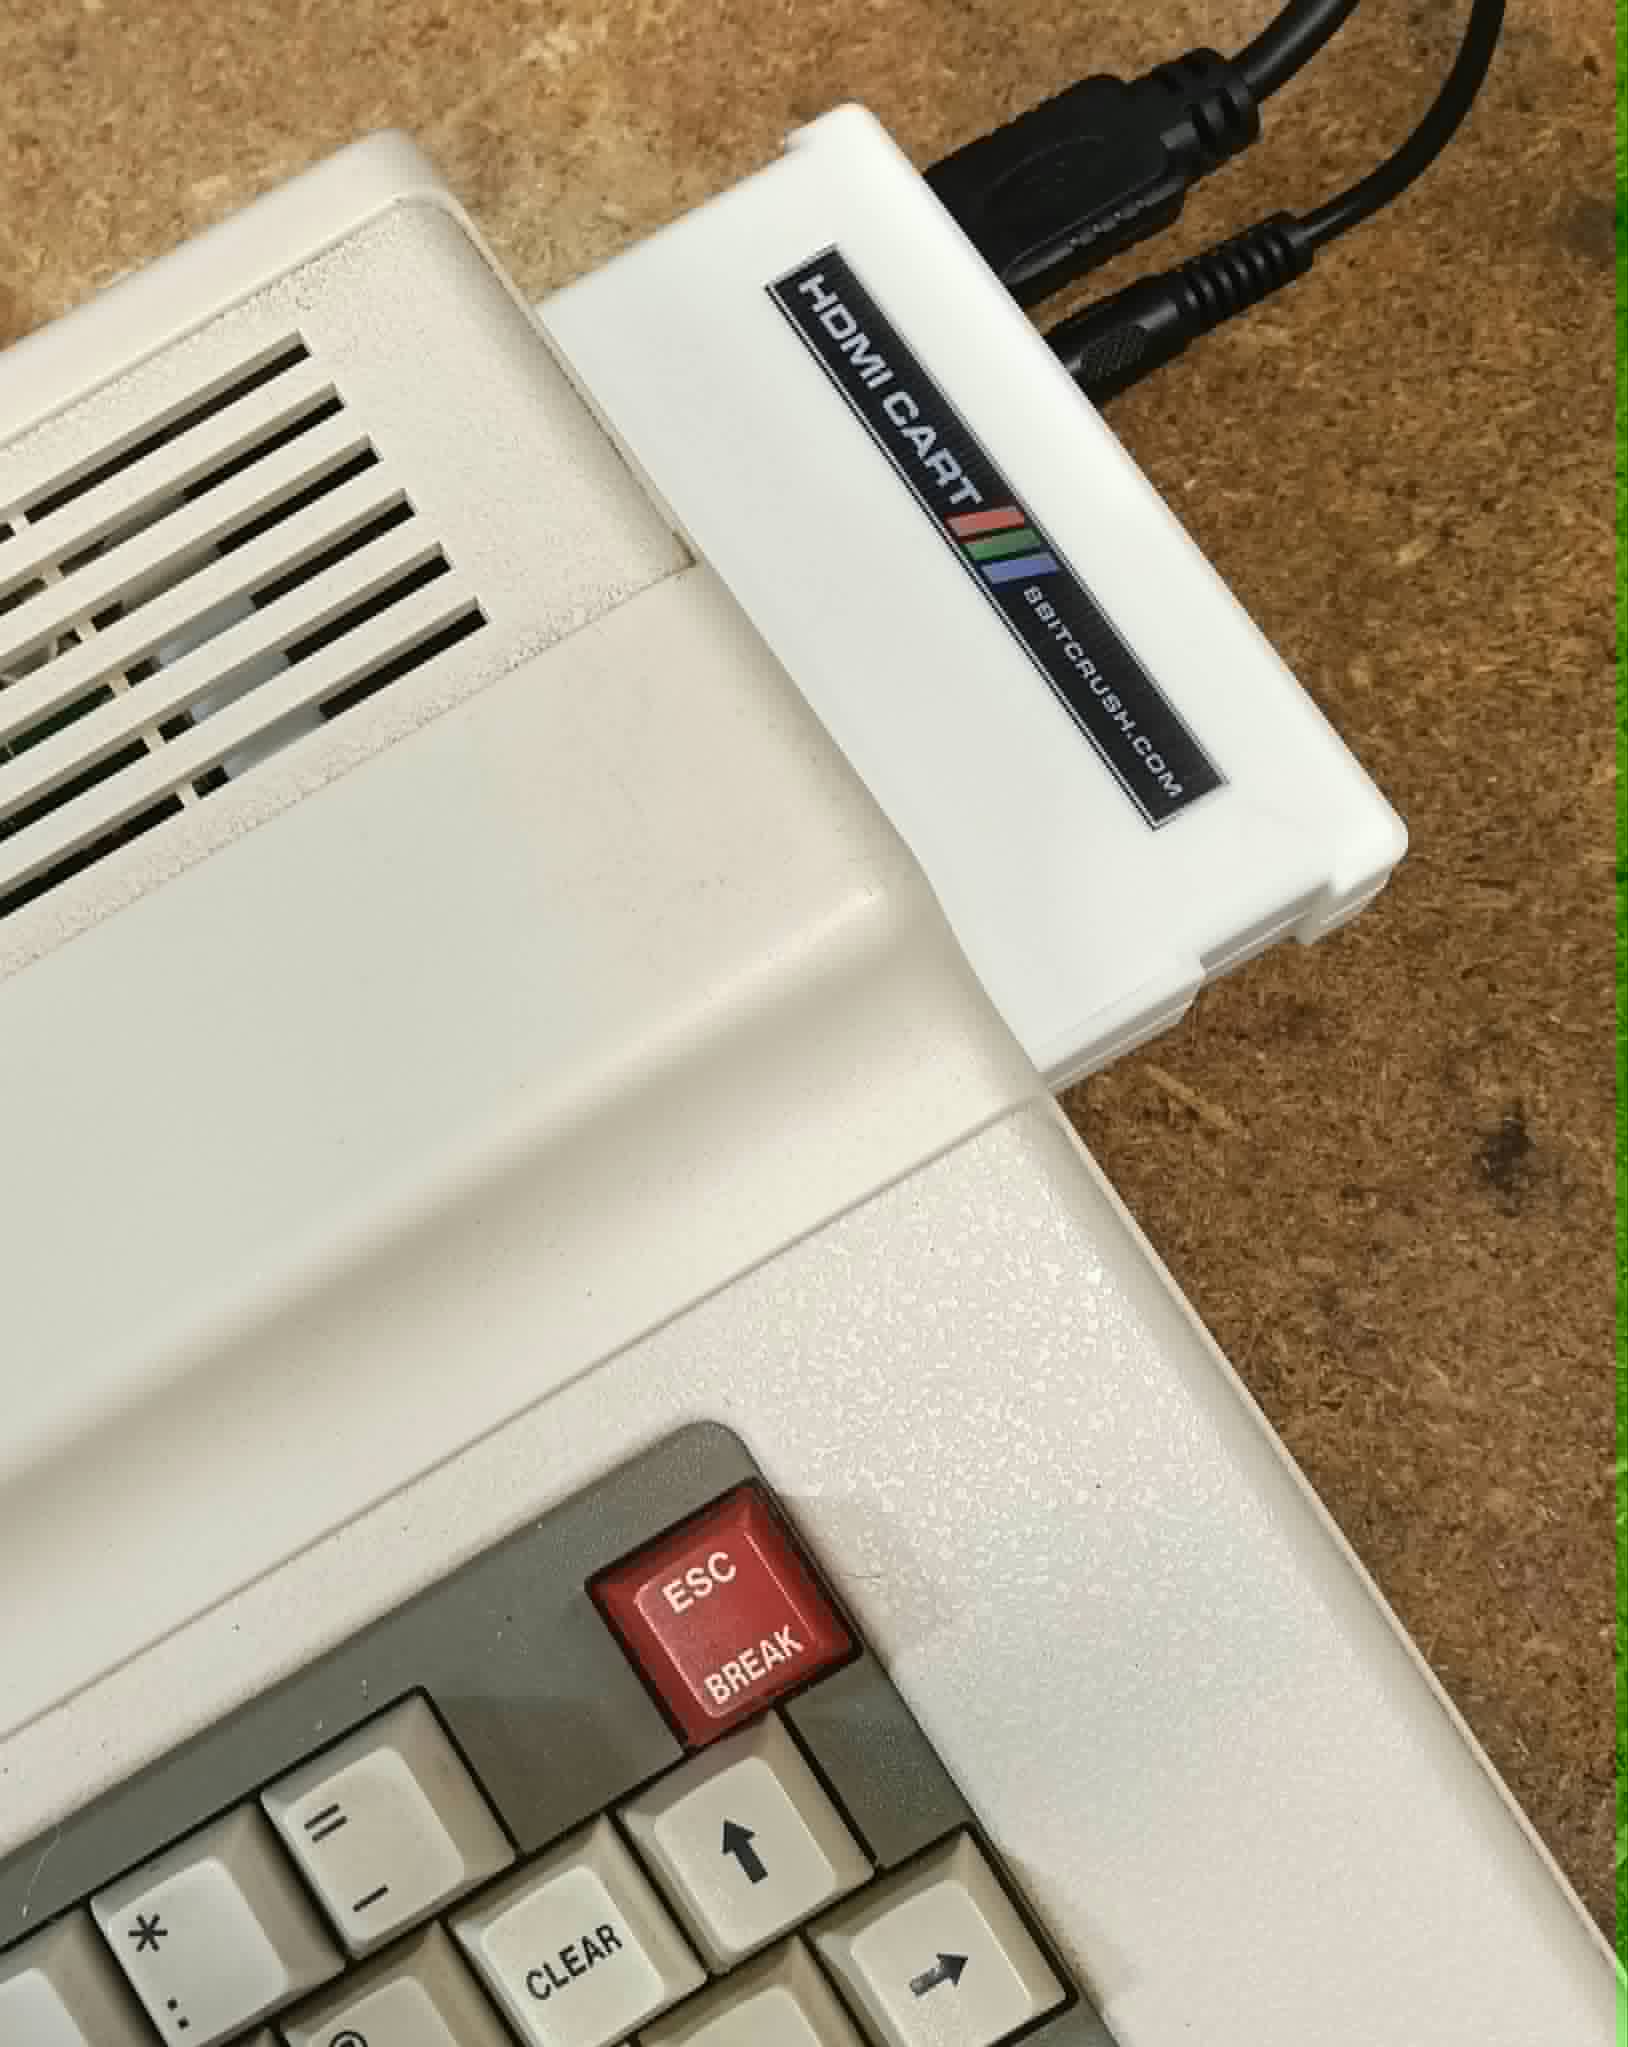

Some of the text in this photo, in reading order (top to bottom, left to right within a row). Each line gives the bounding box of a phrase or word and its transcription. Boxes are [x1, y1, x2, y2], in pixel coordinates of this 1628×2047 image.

[799, 273, 983, 506] HDMI CART
[1023, 586, 1184, 799] 8BITCRUSH.COM
[661, 1551, 736, 1613] ESC
[704, 1625, 804, 1706] BREAK
[525, 1923, 623, 2000] CLEAR
